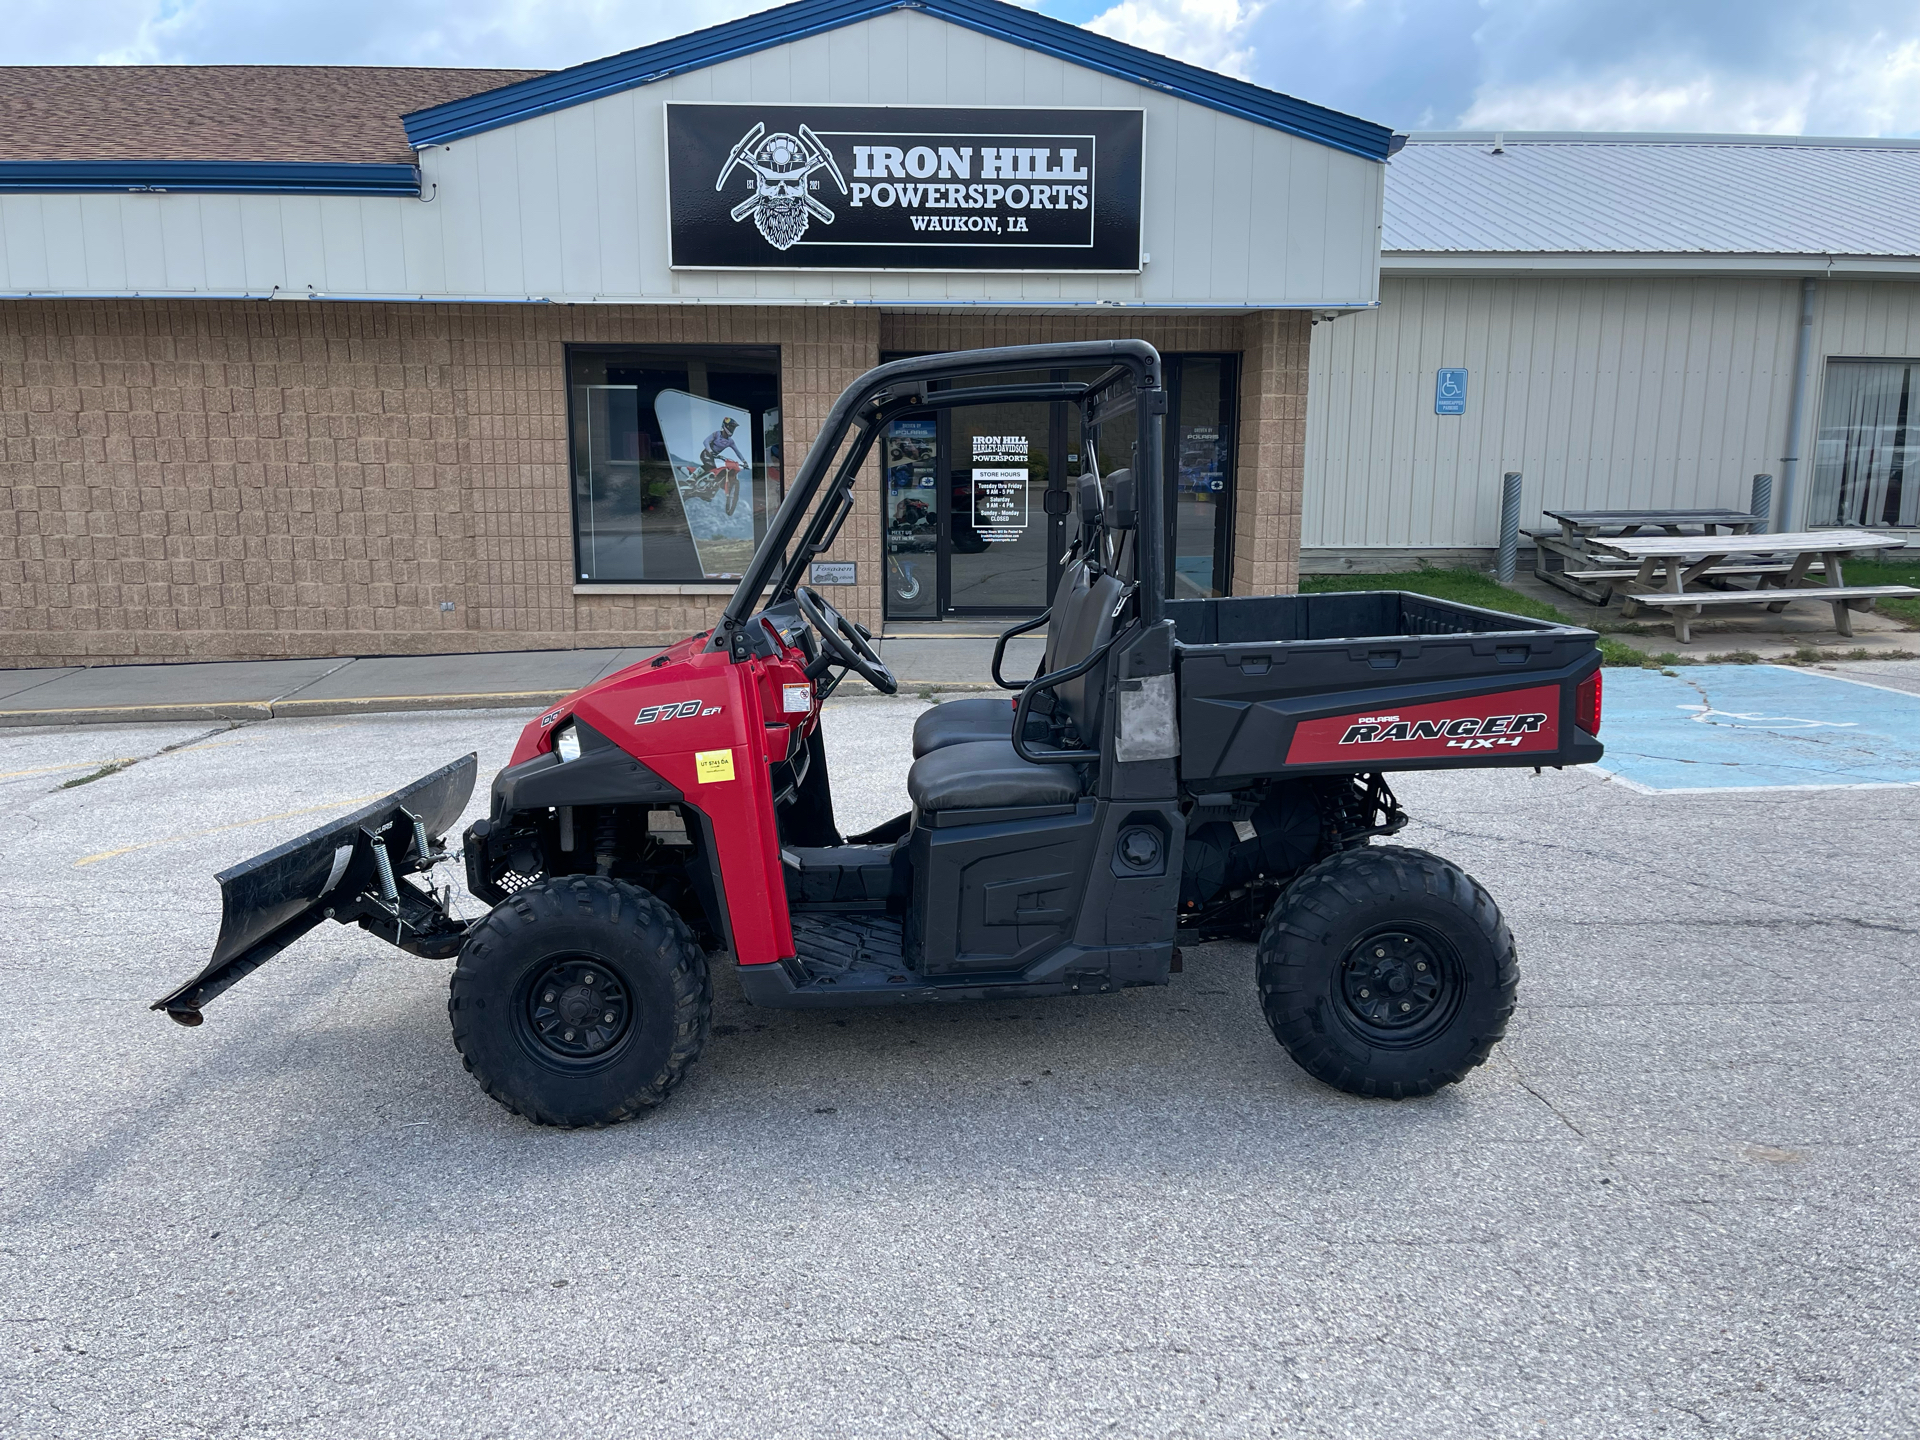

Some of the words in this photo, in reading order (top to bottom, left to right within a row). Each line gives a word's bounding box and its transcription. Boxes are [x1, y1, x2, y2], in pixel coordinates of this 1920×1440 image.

[853, 146, 973, 179] IRON
[981, 147, 1088, 180] HILL
[810, 180, 820, 190] 2021
[850, 183, 1088, 210] POWERSPORTS
[910, 216, 1002, 235] WAUKON,
[1007, 216, 1029, 232] IA
[972, 436, 1001, 444] IRON
[1003, 436, 1028, 444] HILL
[973, 444, 1028, 454] HARLEY-DAVIDSON
[634, 700, 702, 725] 570
[702, 706, 722, 716] EFI
[1358, 716, 1400, 724] POLARIS
[1338, 713, 1547, 745] RANGER
